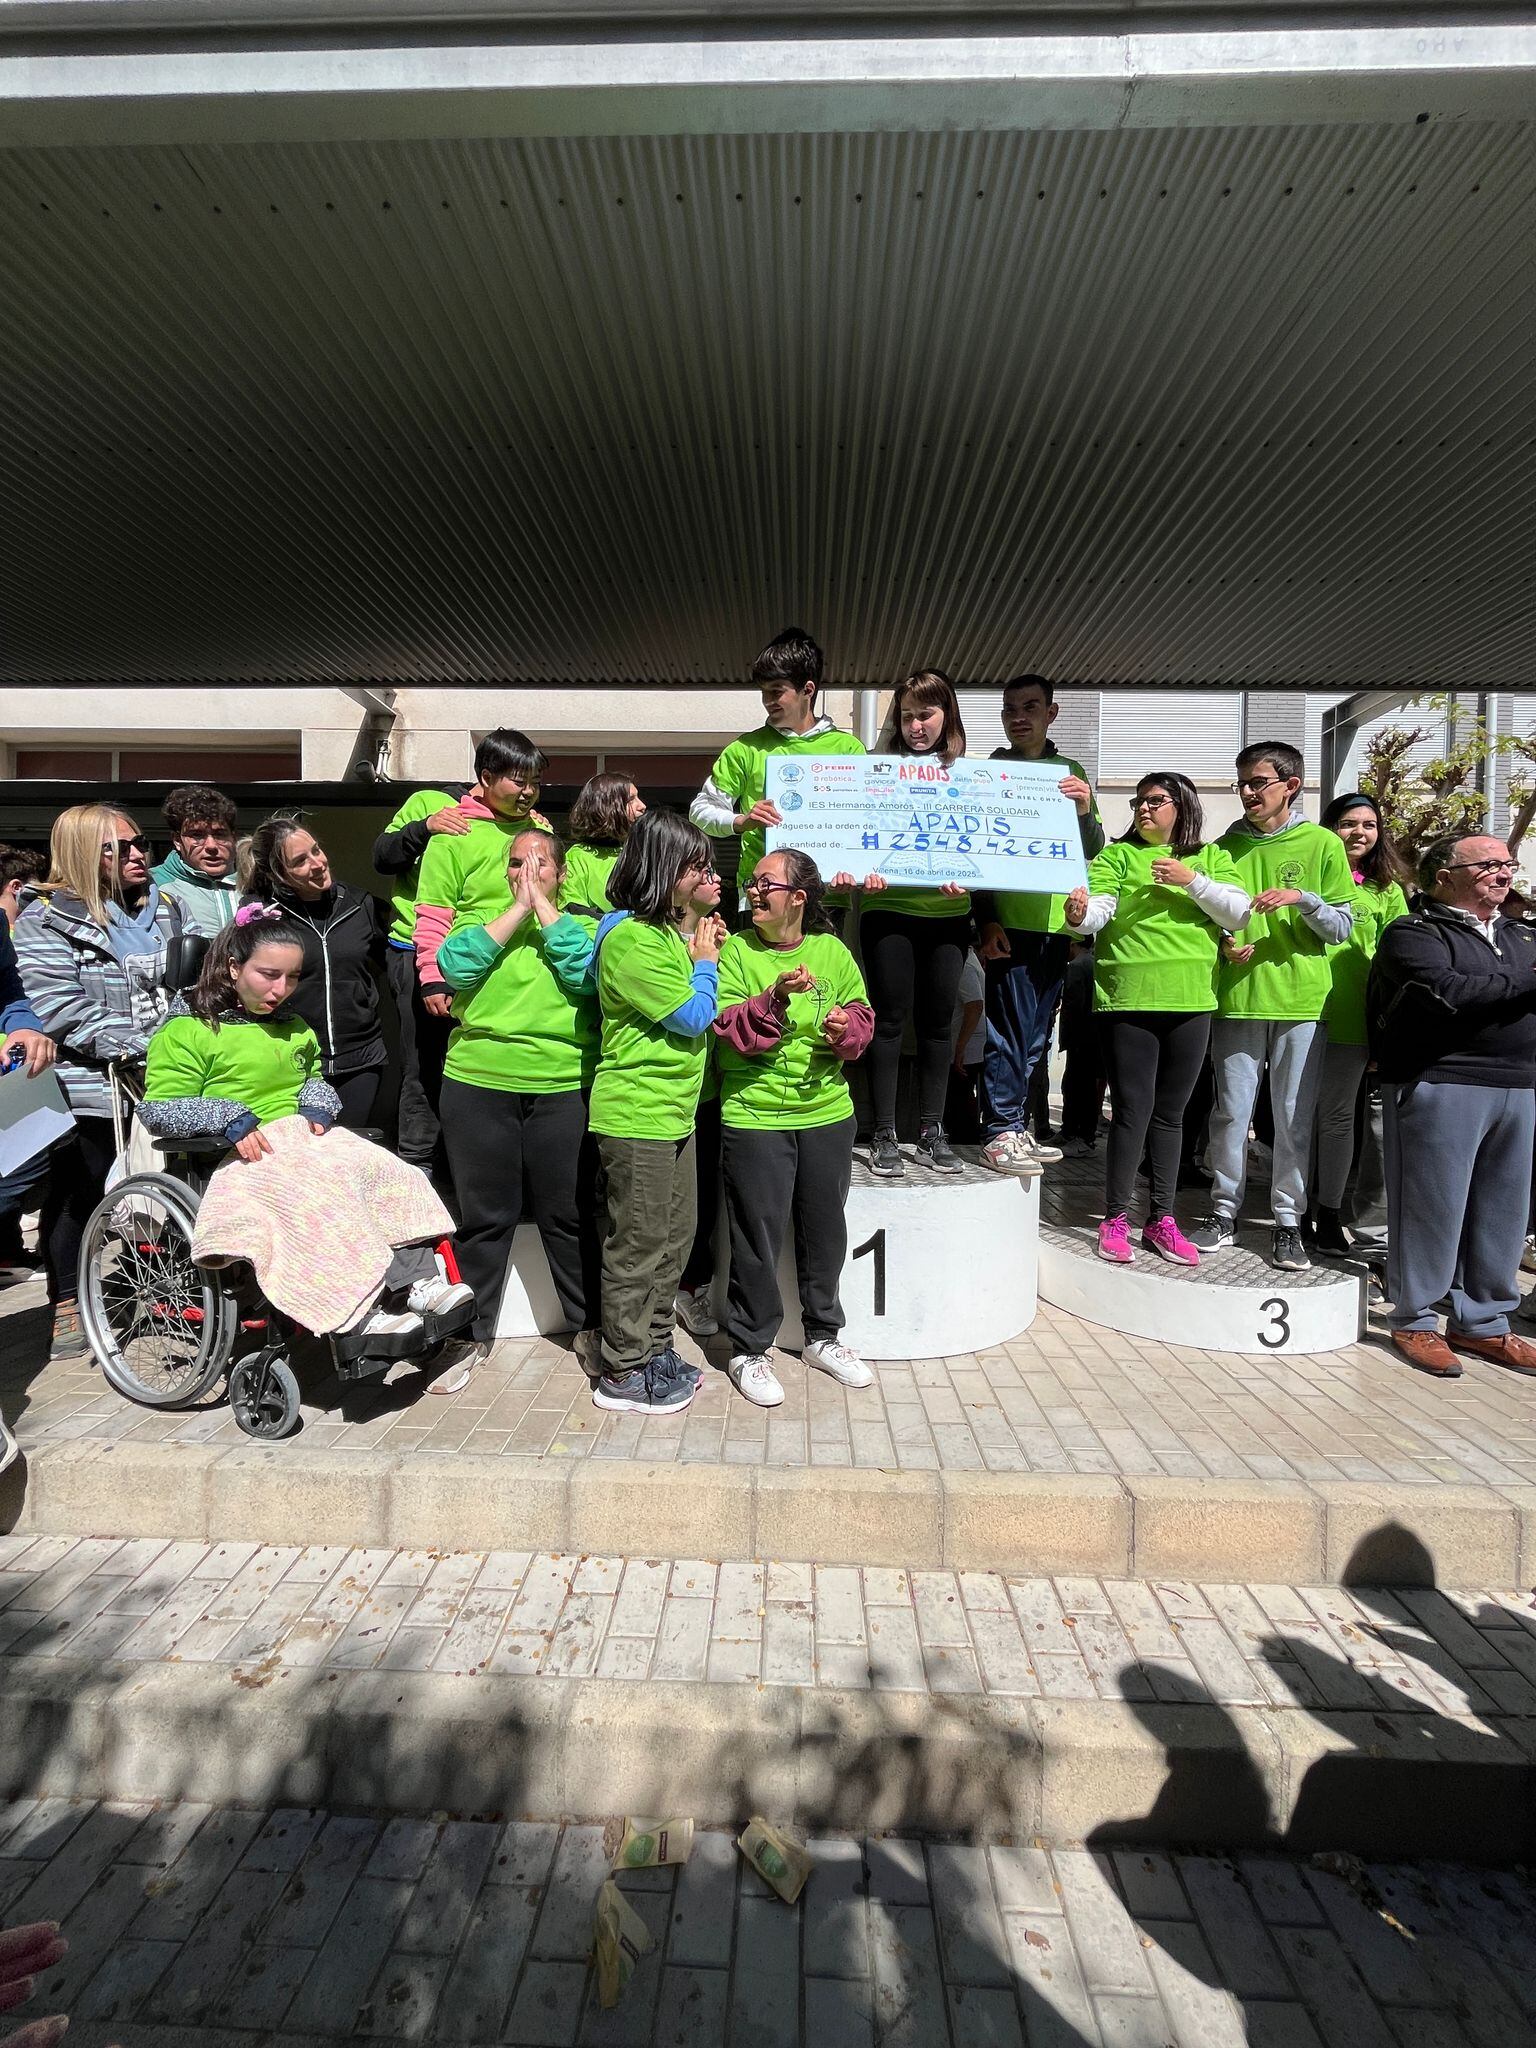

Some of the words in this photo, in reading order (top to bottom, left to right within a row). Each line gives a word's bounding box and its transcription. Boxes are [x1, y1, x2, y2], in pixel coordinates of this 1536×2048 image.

[899, 764, 951, 782] APADIS
[808, 801, 826, 809] IES
[828, 801, 877, 809] Hermanos
[878, 801, 915, 810] Amorós
[923, 803, 932, 811] III
[934, 803, 985, 813] CARRERA
[986, 806, 1041, 817] SOLIDARIA
[776, 822, 815, 831] Páguese
[824, 822, 833, 830] la
[835, 822, 861, 830] orden
[908, 811, 1011, 837] APADIS
[776, 841, 789, 849] La
[789, 841, 827, 849] cantidad
[829, 841, 844, 849] de:
[915, 868, 926, 876] de
[927, 869, 944, 877] abril
[957, 870, 977, 878] 2025
[853, 1229, 885, 1315] 1
[1257, 1298, 1290, 1348] 3
